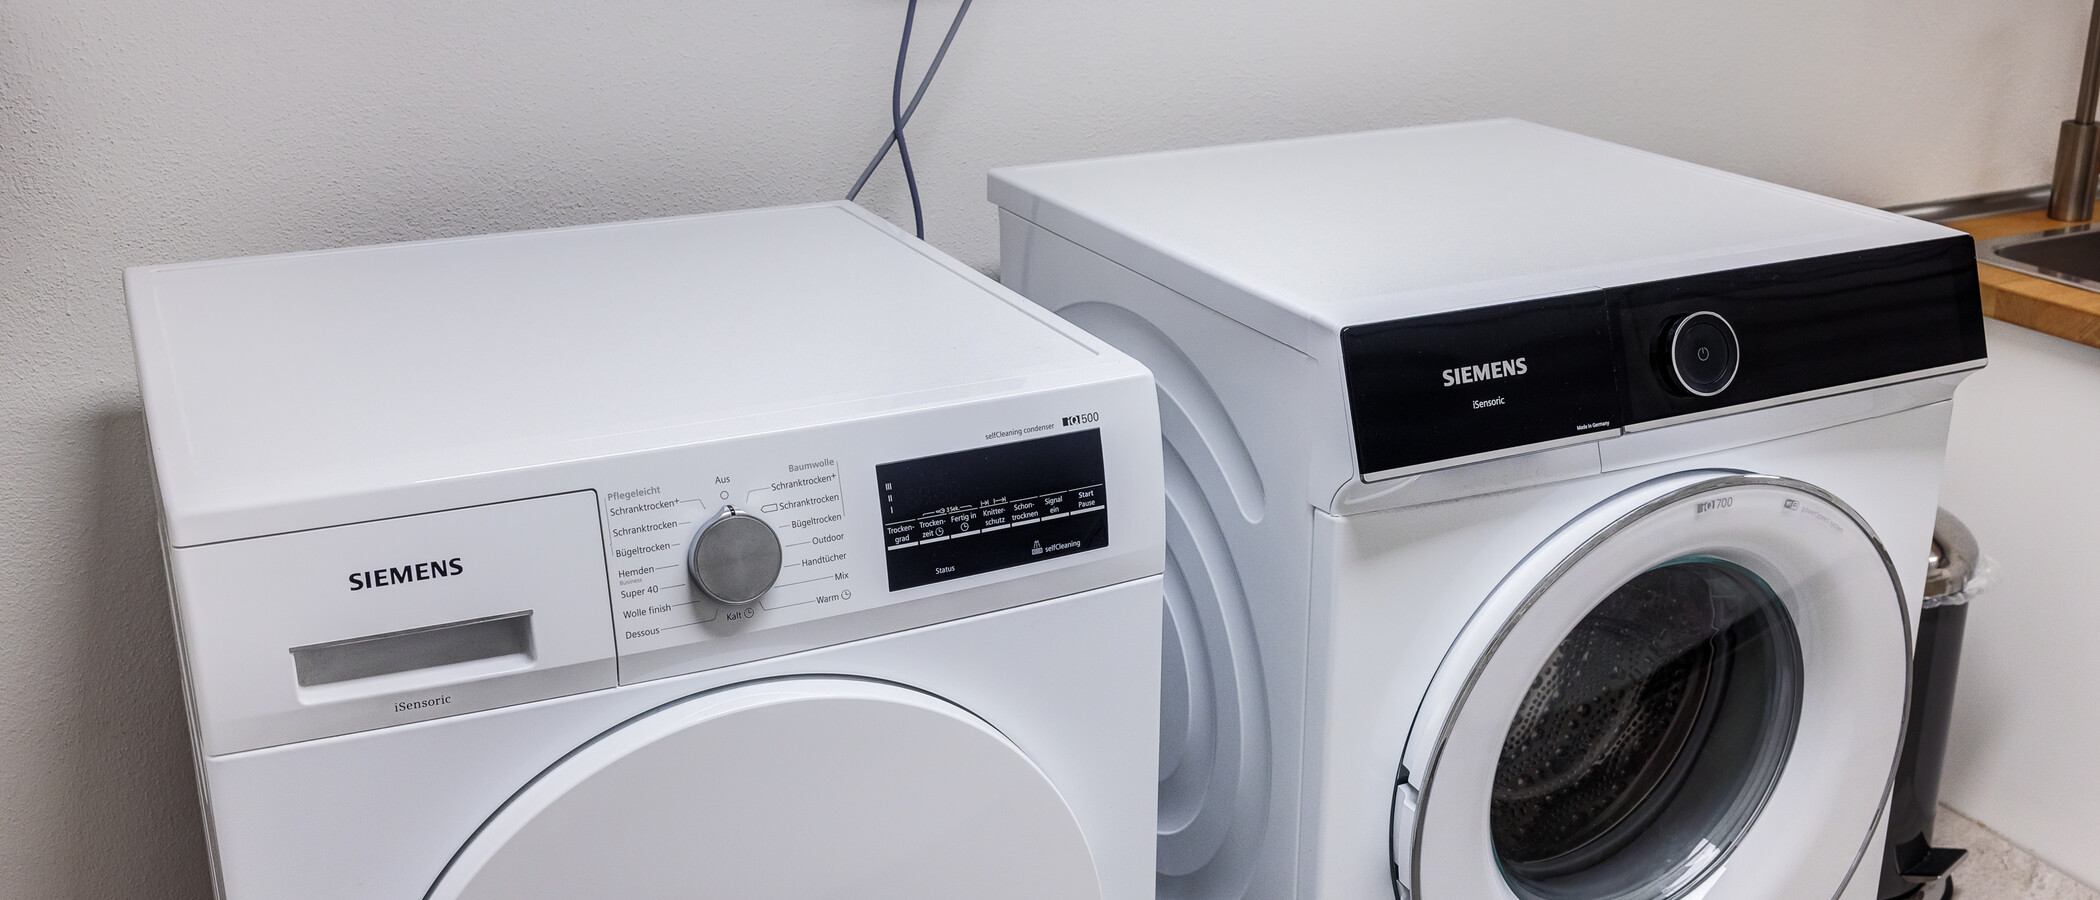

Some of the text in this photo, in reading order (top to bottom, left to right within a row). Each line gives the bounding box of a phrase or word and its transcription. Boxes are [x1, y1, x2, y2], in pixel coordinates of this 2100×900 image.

[1442, 357, 1528, 387] SIEMENS
[1472, 396, 1505, 410] iSensoric
[985, 426, 1022, 440] selfCleaning
[1024, 423, 1054, 434] condenser
[788, 459, 834, 472] Baumwolle
[715, 476, 730, 484] Aus
[771, 473, 836, 492] Schranktrocken+
[608, 486, 661, 502] Pflegeleicht
[1078, 490, 1094, 499] Start
[780, 494, 840, 510] Schranktrocken
[1045, 495, 1062, 506] Signal
[1078, 499, 1096, 508] Pause
[610, 498, 680, 516] Schranktrocken+
[983, 508, 1006, 517] Knitter-
[1014, 502, 1034, 512] Schon-
[1050, 506, 1060, 514] ein
[792, 513, 842, 529] Bügeltrocken
[950, 511, 977, 523] Fertig in
[985, 517, 1006, 526] schutz
[1012, 511, 1038, 521] trocknen
[612, 520, 678, 537] Schranktrocken
[887, 524, 914, 534] Trocken-
[920, 519, 946, 529] Trocken-
[812, 533, 844, 545] Outdoor
[894, 534, 910, 544] grad
[922, 530, 934, 538] zeit
[616, 542, 670, 558] Bügeltrocken
[1045, 540, 1080, 552] selfCleaning
[802, 552, 847, 568] Handtücher
[348, 558, 464, 591] SIEMENS
[618, 566, 654, 578] Hemden
[935, 565, 955, 575] Status
[834, 572, 849, 581] Mix
[620, 585, 658, 599] Super 40
[816, 594, 840, 604] Warm
[623, 604, 672, 619] Wolle finish
[726, 612, 742, 622] Kalt
[625, 628, 660, 640] Dessous
[394, 694, 451, 712] iSensoric
